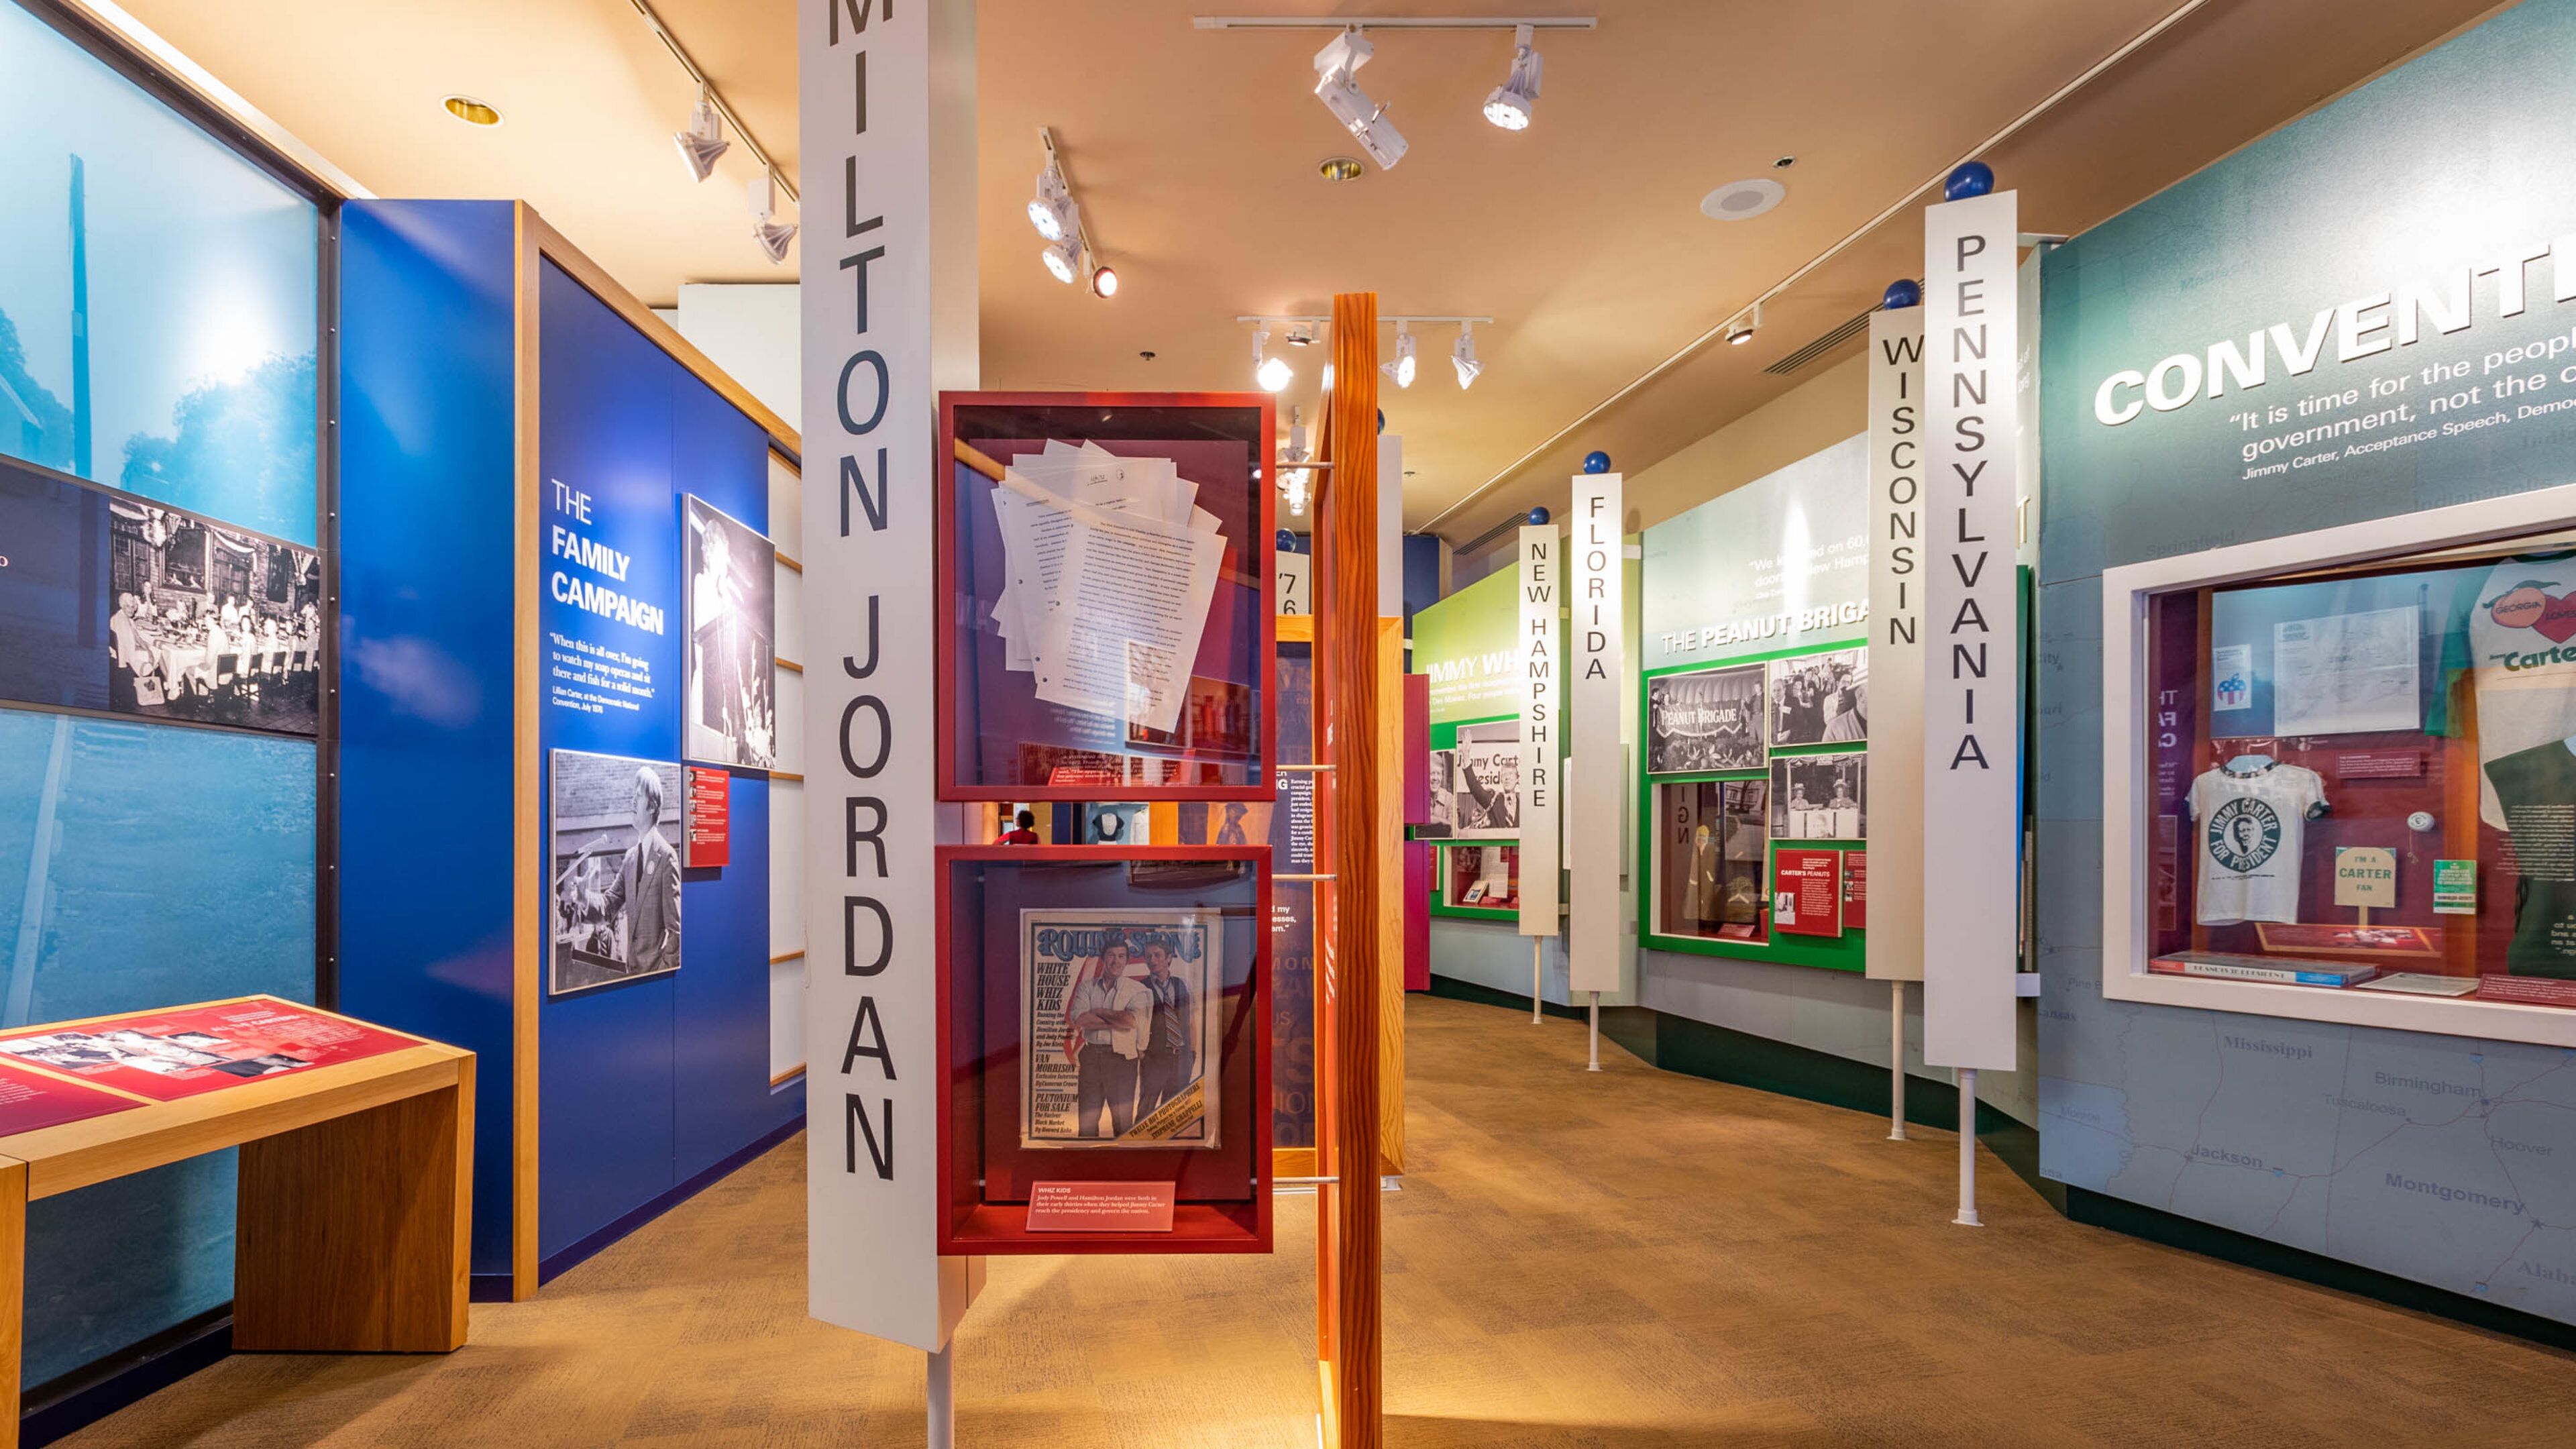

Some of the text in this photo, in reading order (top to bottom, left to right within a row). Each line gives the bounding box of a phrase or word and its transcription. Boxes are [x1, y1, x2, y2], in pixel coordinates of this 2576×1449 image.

[2229, 411, 2259, 431] “It
[2269, 405, 2289, 425] is
[2298, 389, 2359, 417] time
[2369, 374, 2411, 398] for
[2420, 360, 2471, 386] the
[2242, 403, 2416, 462] government,
[2430, 386, 2482, 415] not
[2492, 372, 2547, 400] the
[2242, 462, 2290, 480] Jimmy
[2292, 450, 2340, 469] Carter,
[2344, 429, 2437, 459] Acceptance
[2443, 411, 2512, 436] Speech,
[551, 478, 592, 525] THE
[1882, 334, 1925, 645] WISCONSIN
[1950, 235, 1990, 770] PENNSYLVANIA
[552, 524, 631, 582] FAMILY
[1527, 543, 1551, 603] NEW
[1585, 496, 1607, 680] FLORIDA
[551, 570, 664, 636] CAMPAIGN
[2496, 602, 2542, 614] GEORGIA
[1662, 630, 1697, 656] THE
[1701, 613, 1791, 649] PEANUT
[576, 639, 588, 653] this
[590, 643, 595, 655] is
[596, 646, 604, 657] all
[553, 651, 561, 661] to
[562, 655, 582, 667] watch
[584, 659, 594, 672] my
[595, 663, 610, 676] soap
[553, 665, 572, 680] there
[573, 672, 586, 683] and
[588, 674, 599, 686] fish
[601, 678, 610, 689] for
[1529, 619, 1549, 807] HAMPSHIRE
[1661, 708, 1737, 726] PEANUT BRIGADE
[2210, 798, 2278, 835] JIMMY CARTER
[2210, 839, 2231, 861] FOR
[2339, 867, 2392, 879] CARTER
[839, 594, 897, 1181] JORDAN
[2356, 883, 2373, 892] FAN
[1277, 906, 1291, 915] my
[1036, 962, 1071, 974] WHITE
[1037, 975, 1071, 986] HOUSE
[1036, 987, 1064, 999] WHIZ
[1036, 999, 1063, 1010] KIDS
[1036, 1054, 1051, 1063] VAN
[2224, 1035, 2313, 1060] Mississippi
[1036, 1063, 1077, 1073] MORRISON
[2375, 1071, 2482, 1097] Birmingham
[1036, 1093, 1079, 1103] PLUTONIUM
[1036, 1102, 1071, 1112] FOR SALE
[2324, 1093, 2407, 1118] Tuscaloosa
[2191, 1143, 2263, 1169] Jackson
[2492, 1134, 2554, 1157] Hoover
[2385, 1173, 2526, 1216] Montgomery
